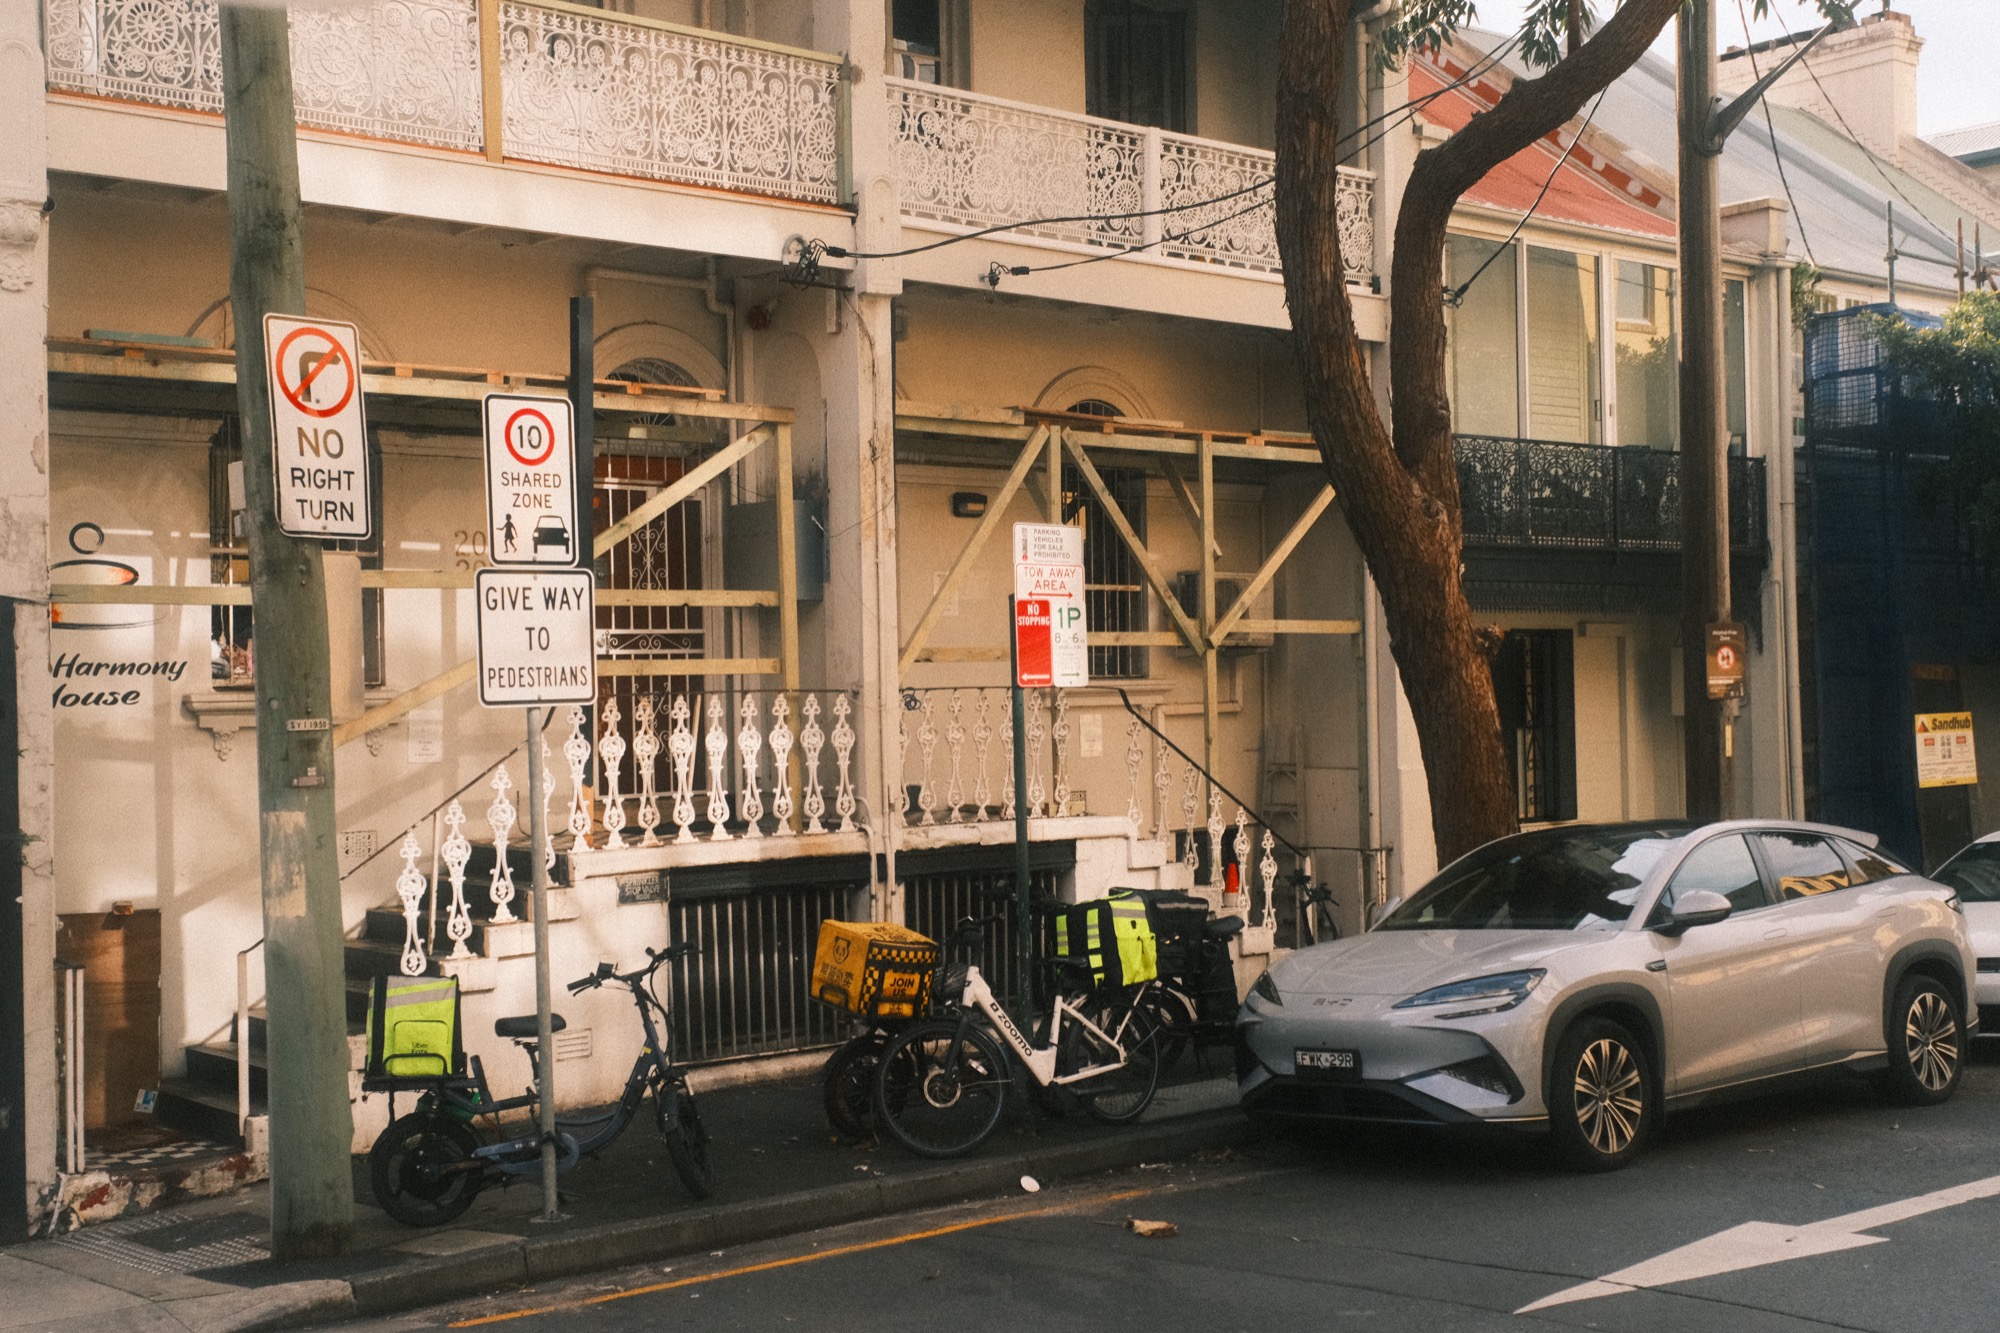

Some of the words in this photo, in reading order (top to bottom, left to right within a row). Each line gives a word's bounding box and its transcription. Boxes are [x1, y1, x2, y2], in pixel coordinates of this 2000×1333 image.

[297, 427, 344, 459] NO
[517, 425, 542, 450] 10
[290, 467, 355, 491] RIGHT
[501, 471, 562, 488] SHARED
[512, 493, 552, 509] ZONE
[296, 498, 354, 522] TURN
[1033, 528, 1061, 536] PARKING
[1024, 567, 1043, 578] TOW
[1049, 568, 1076, 578] AWAY
[1034, 580, 1067, 591] AREA
[486, 586, 533, 611] GIVE
[543, 587, 584, 611] WAY
[1027, 604, 1040, 615] NO
[1058, 607, 1081, 629] 1P
[1018, 616, 1050, 626] STOPPING
[525, 626, 550, 651] TO
[52, 652, 188, 681] Harmony
[488, 666, 588, 688] PEDESTRIANS
[1932, 716, 1971, 731] Sandhub
[890, 978, 915, 988] JOIN
[892, 988, 906, 997] US
[1313, 998, 1352, 1006] BYD
[998, 1013, 1032, 1057] zoomo
